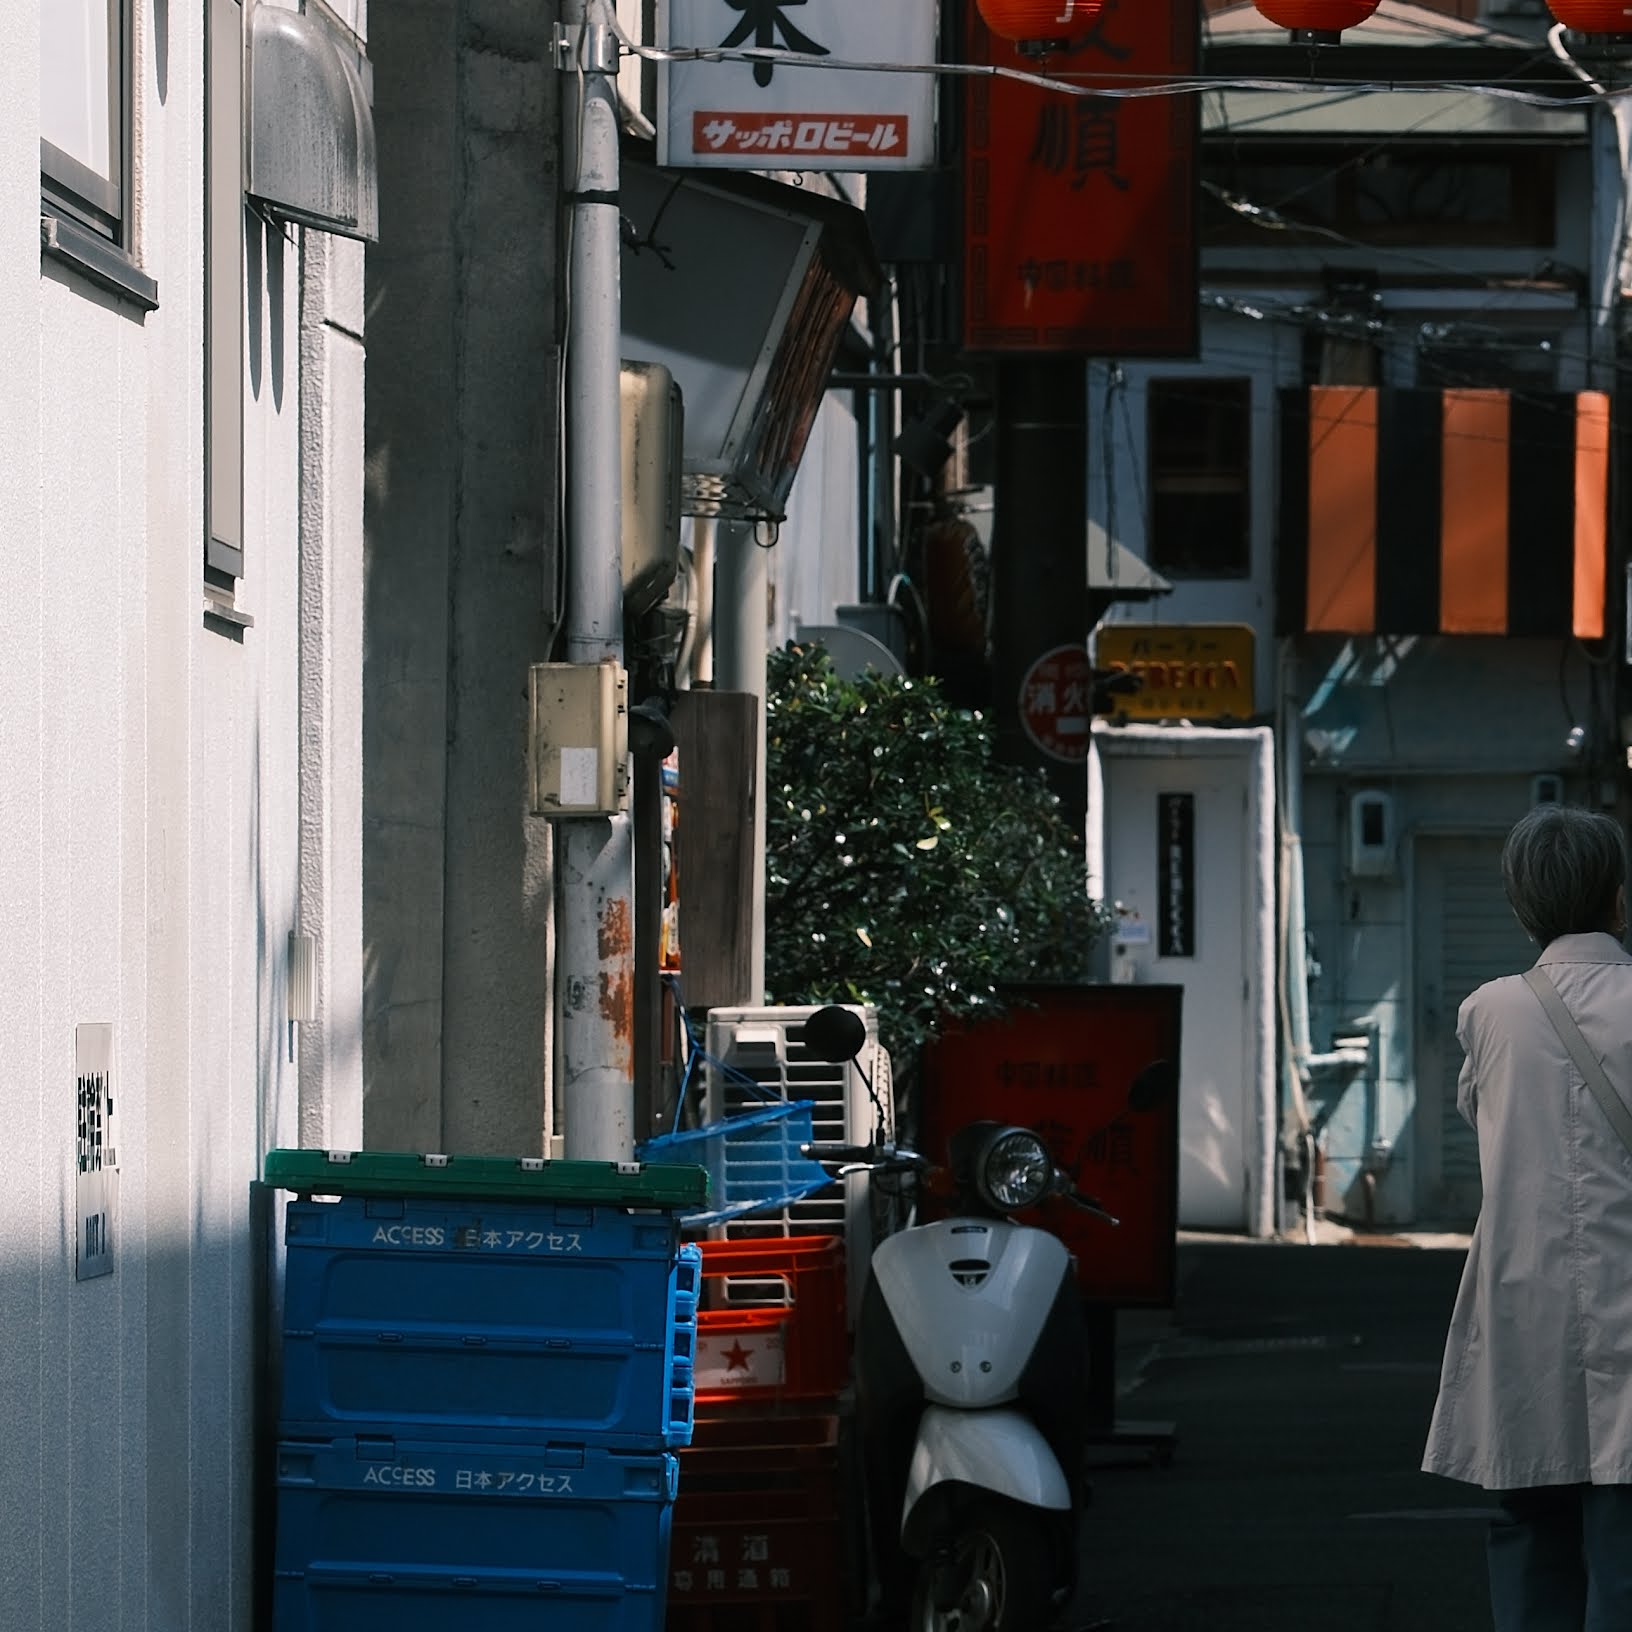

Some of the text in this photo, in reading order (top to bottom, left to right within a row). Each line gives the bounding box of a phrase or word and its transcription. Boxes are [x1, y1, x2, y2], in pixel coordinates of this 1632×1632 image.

[702, 118, 899, 152] サッポロビール
[464, 1228, 582, 1253] 日本アクセス
[455, 1469, 573, 1494] 日本アクセス
